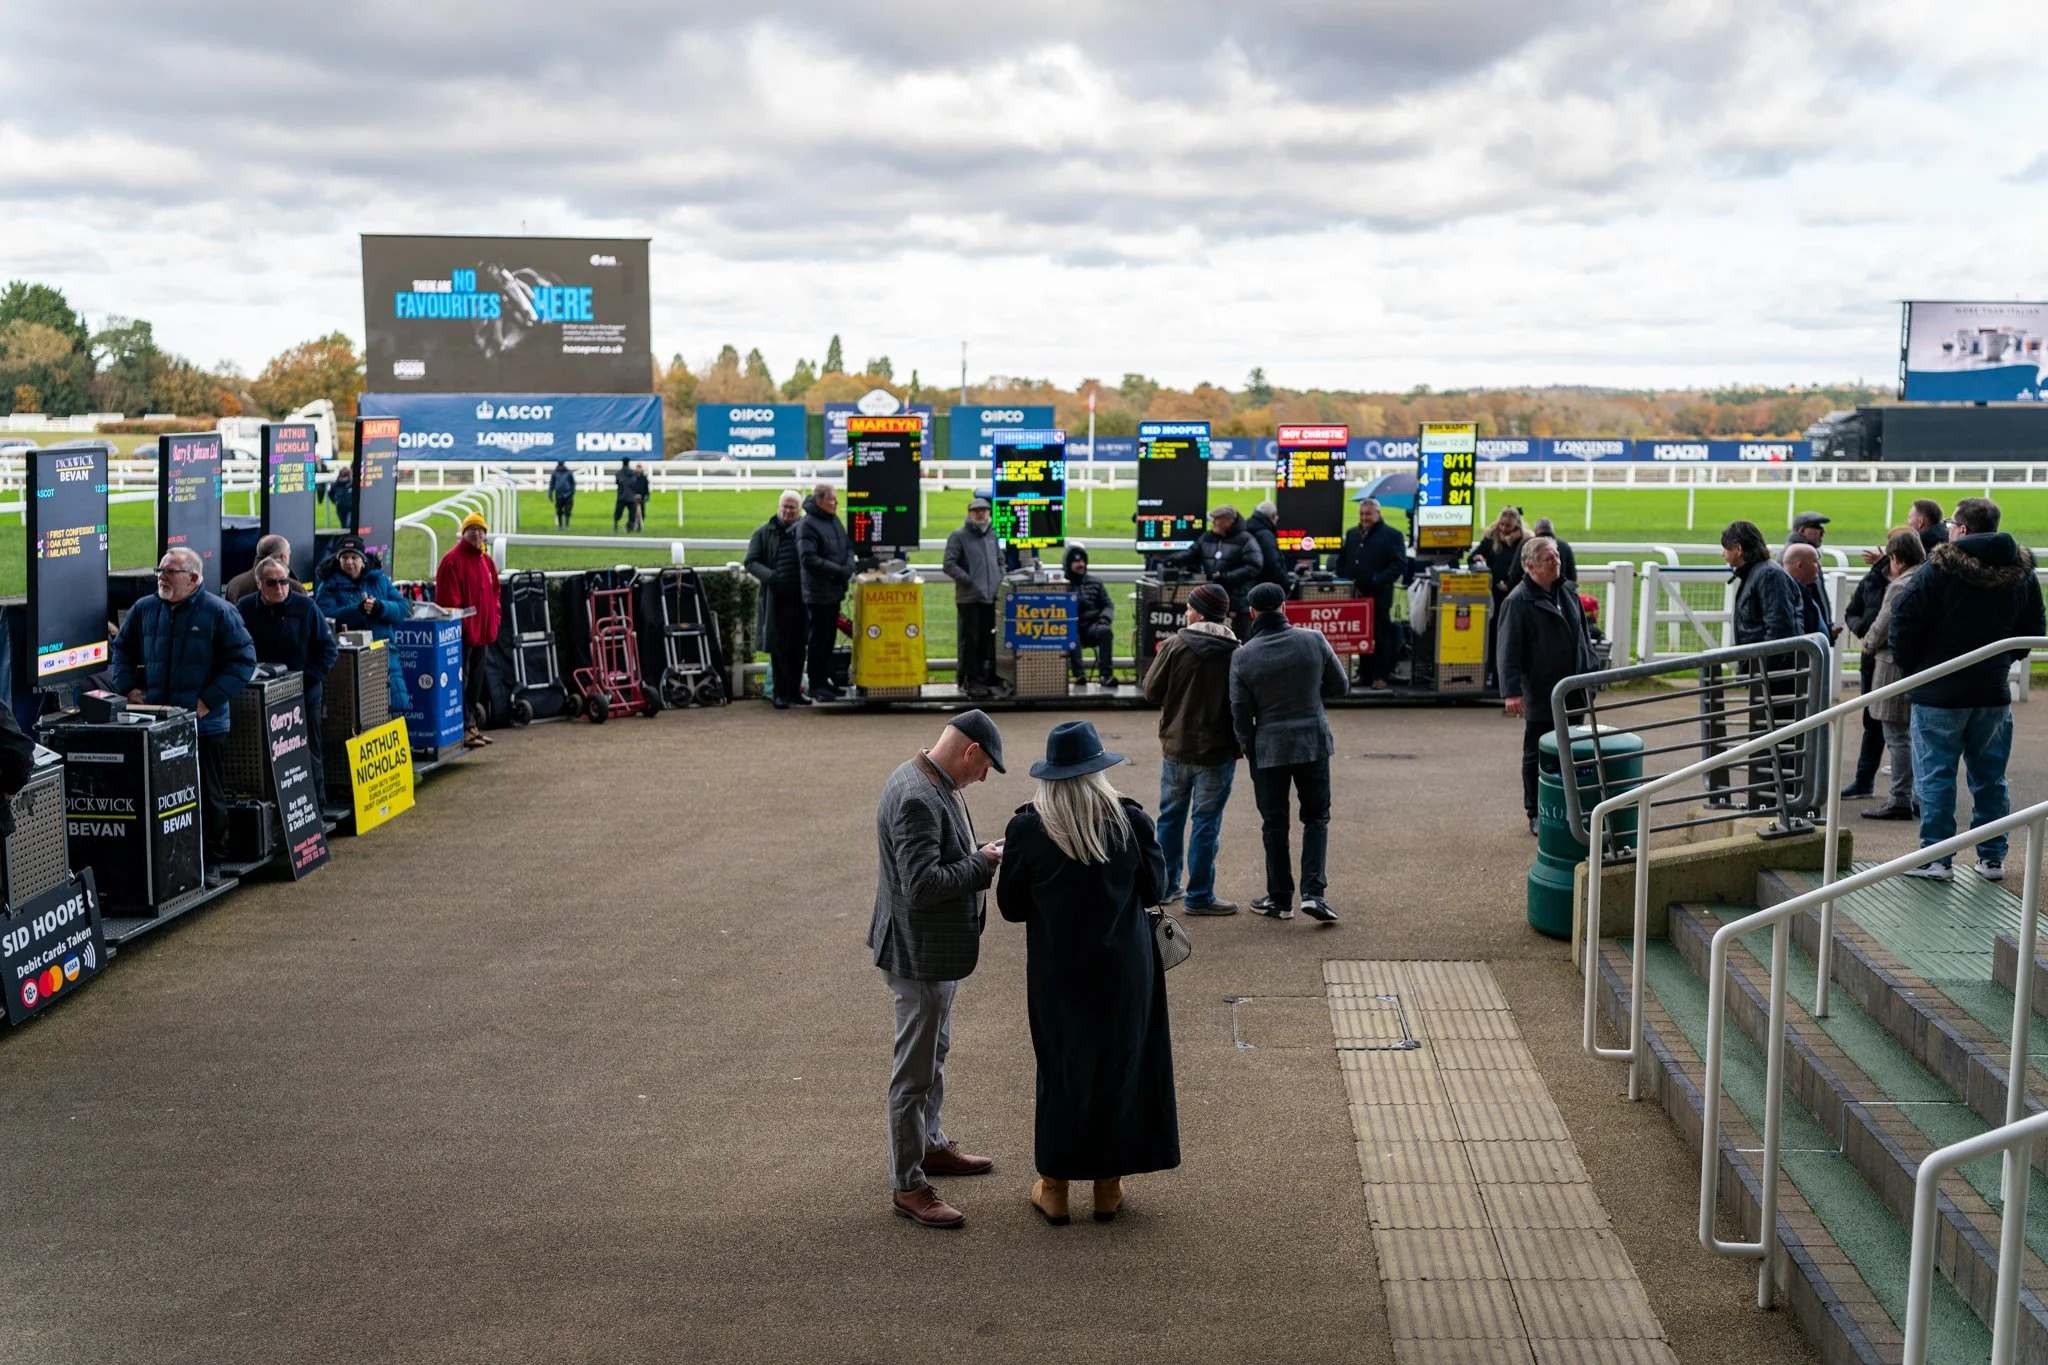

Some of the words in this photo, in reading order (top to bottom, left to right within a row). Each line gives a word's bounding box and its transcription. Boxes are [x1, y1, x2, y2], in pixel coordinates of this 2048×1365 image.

[452, 269, 476, 292] NO
[396, 292, 502, 319] FAVOURITES
[532, 286, 594, 321] HERE
[496, 406, 553, 420] ASCOT
[364, 420, 399, 435] MARTYN
[852, 420, 917, 430] MARTYN
[1141, 426, 1161, 434] SID
[1162, 426, 1206, 434] HOOPER
[278, 428, 307, 439] ARTHUR
[477, 432, 554, 446] LONGINES
[1282, 430, 1300, 438] ROY
[1302, 430, 1344, 438] CHRISTIE
[275, 442, 310, 453] NICHOLAS
[1554, 440, 1624, 454] LONGINES
[56, 455, 94, 468] PICKWICK
[1421, 454, 1428, 468] 1
[1443, 453, 1472, 469] 8/11
[60, 470, 89, 482] BEVAN
[1420, 472, 1429, 486] 4
[1450, 471, 1473, 487] 6/4
[1419, 491, 1428, 505] 3
[1449, 490, 1471, 505] 8/1
[1444, 512, 1464, 520] Only
[50, 529, 65, 539] FIRST
[50, 540, 61, 549] OAK
[62, 537, 79, 547] GROVE
[50, 548, 67, 558] MILAN
[866, 592, 918, 601] MARTYN
[1016, 604, 1067, 618] Kevin
[1150, 612, 1173, 625] SID
[1311, 608, 1342, 620] ROY
[395, 630, 433, 645] RTYN
[1016, 620, 1067, 640] Myles
[271, 711, 292, 732] Barry
[272, 735, 300, 762] Johnson
[360, 730, 400, 763] ARTHUR
[356, 748, 407, 786] NICHOLAS
[281, 777, 292, 789] Large
[292, 770, 308, 783] Wagers
[368, 783, 378, 793] CASH
[379, 778, 388, 787] BETS
[388, 772, 400, 783] TAKEN
[364, 801, 375, 812] DEBIT
[376, 794, 388, 806] CARDS
[388, 784, 407, 800] ACCEPTED
[369, 789, 382, 801] EUROS
[382, 780, 400, 795] ACCEPTED
[158, 786, 196, 811] PICKWICK
[289, 800, 297, 811] Bet
[297, 794, 308, 807] With
[304, 803, 313, 814] Euro
[164, 812, 192, 835] BEVAN
[289, 823, 294, 832] &
[293, 817, 305, 830] Debit
[305, 811, 316, 824] Cards
[68, 822, 125, 837] BEVAN
[2, 926, 30, 958] SID
[17, 956, 42, 979] Debit
[42, 943, 67, 961] Cards
[67, 927, 92, 949] Taken
[25, 987, 36, 1000] 18+
[66, 961, 78, 972] VISA
